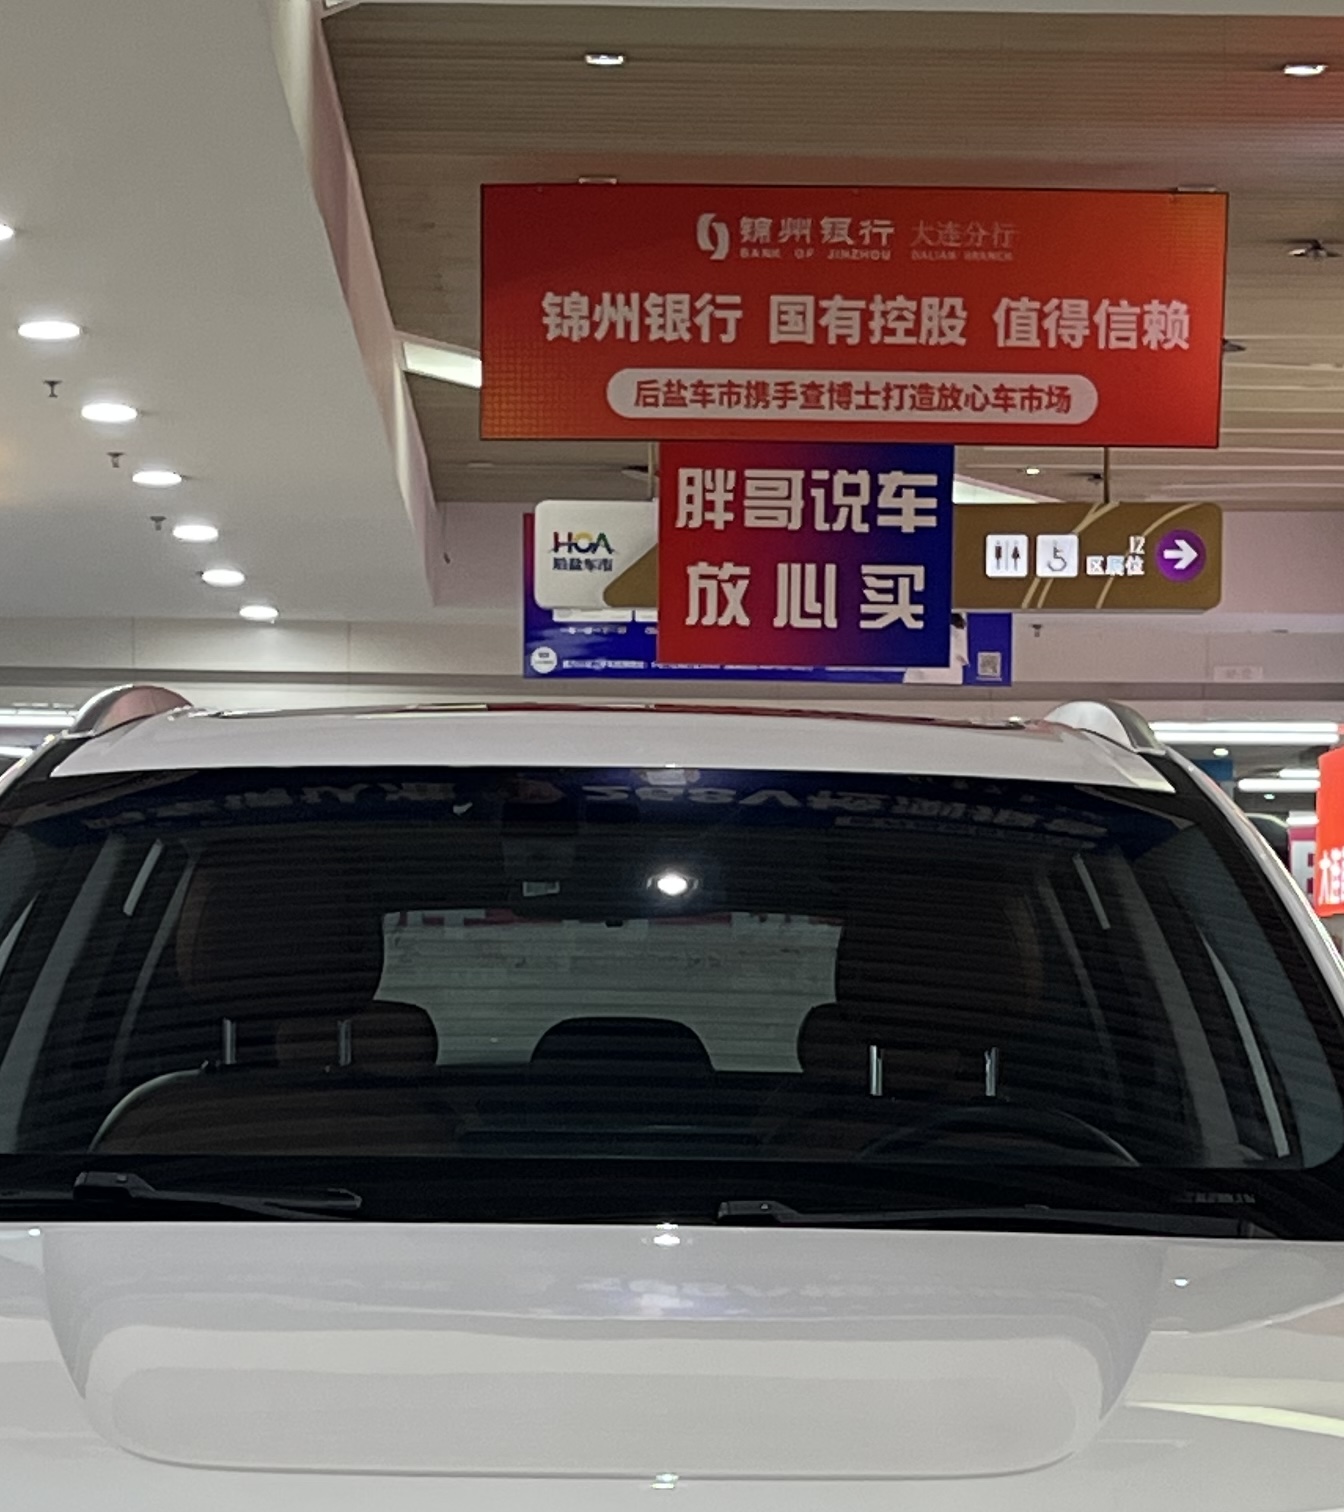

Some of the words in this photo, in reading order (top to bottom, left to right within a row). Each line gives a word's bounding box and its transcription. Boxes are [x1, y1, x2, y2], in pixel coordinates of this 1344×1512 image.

[739, 216, 896, 247] 锦州银行
[911, 219, 1018, 248] 大连分行
[739, 247, 782, 259] BANK
[794, 248, 815, 260] OF
[827, 248, 892, 261] JINZHOU
[541, 291, 743, 343] 锦州银行
[768, 293, 968, 346] 国有控股
[992, 296, 1191, 351] 值得信赖
[633, 379, 1072, 414] 后盐车市携手查博士打造放心车市场
[675, 467, 939, 533] 胖哥说车
[685, 561, 926, 629] 放心买
